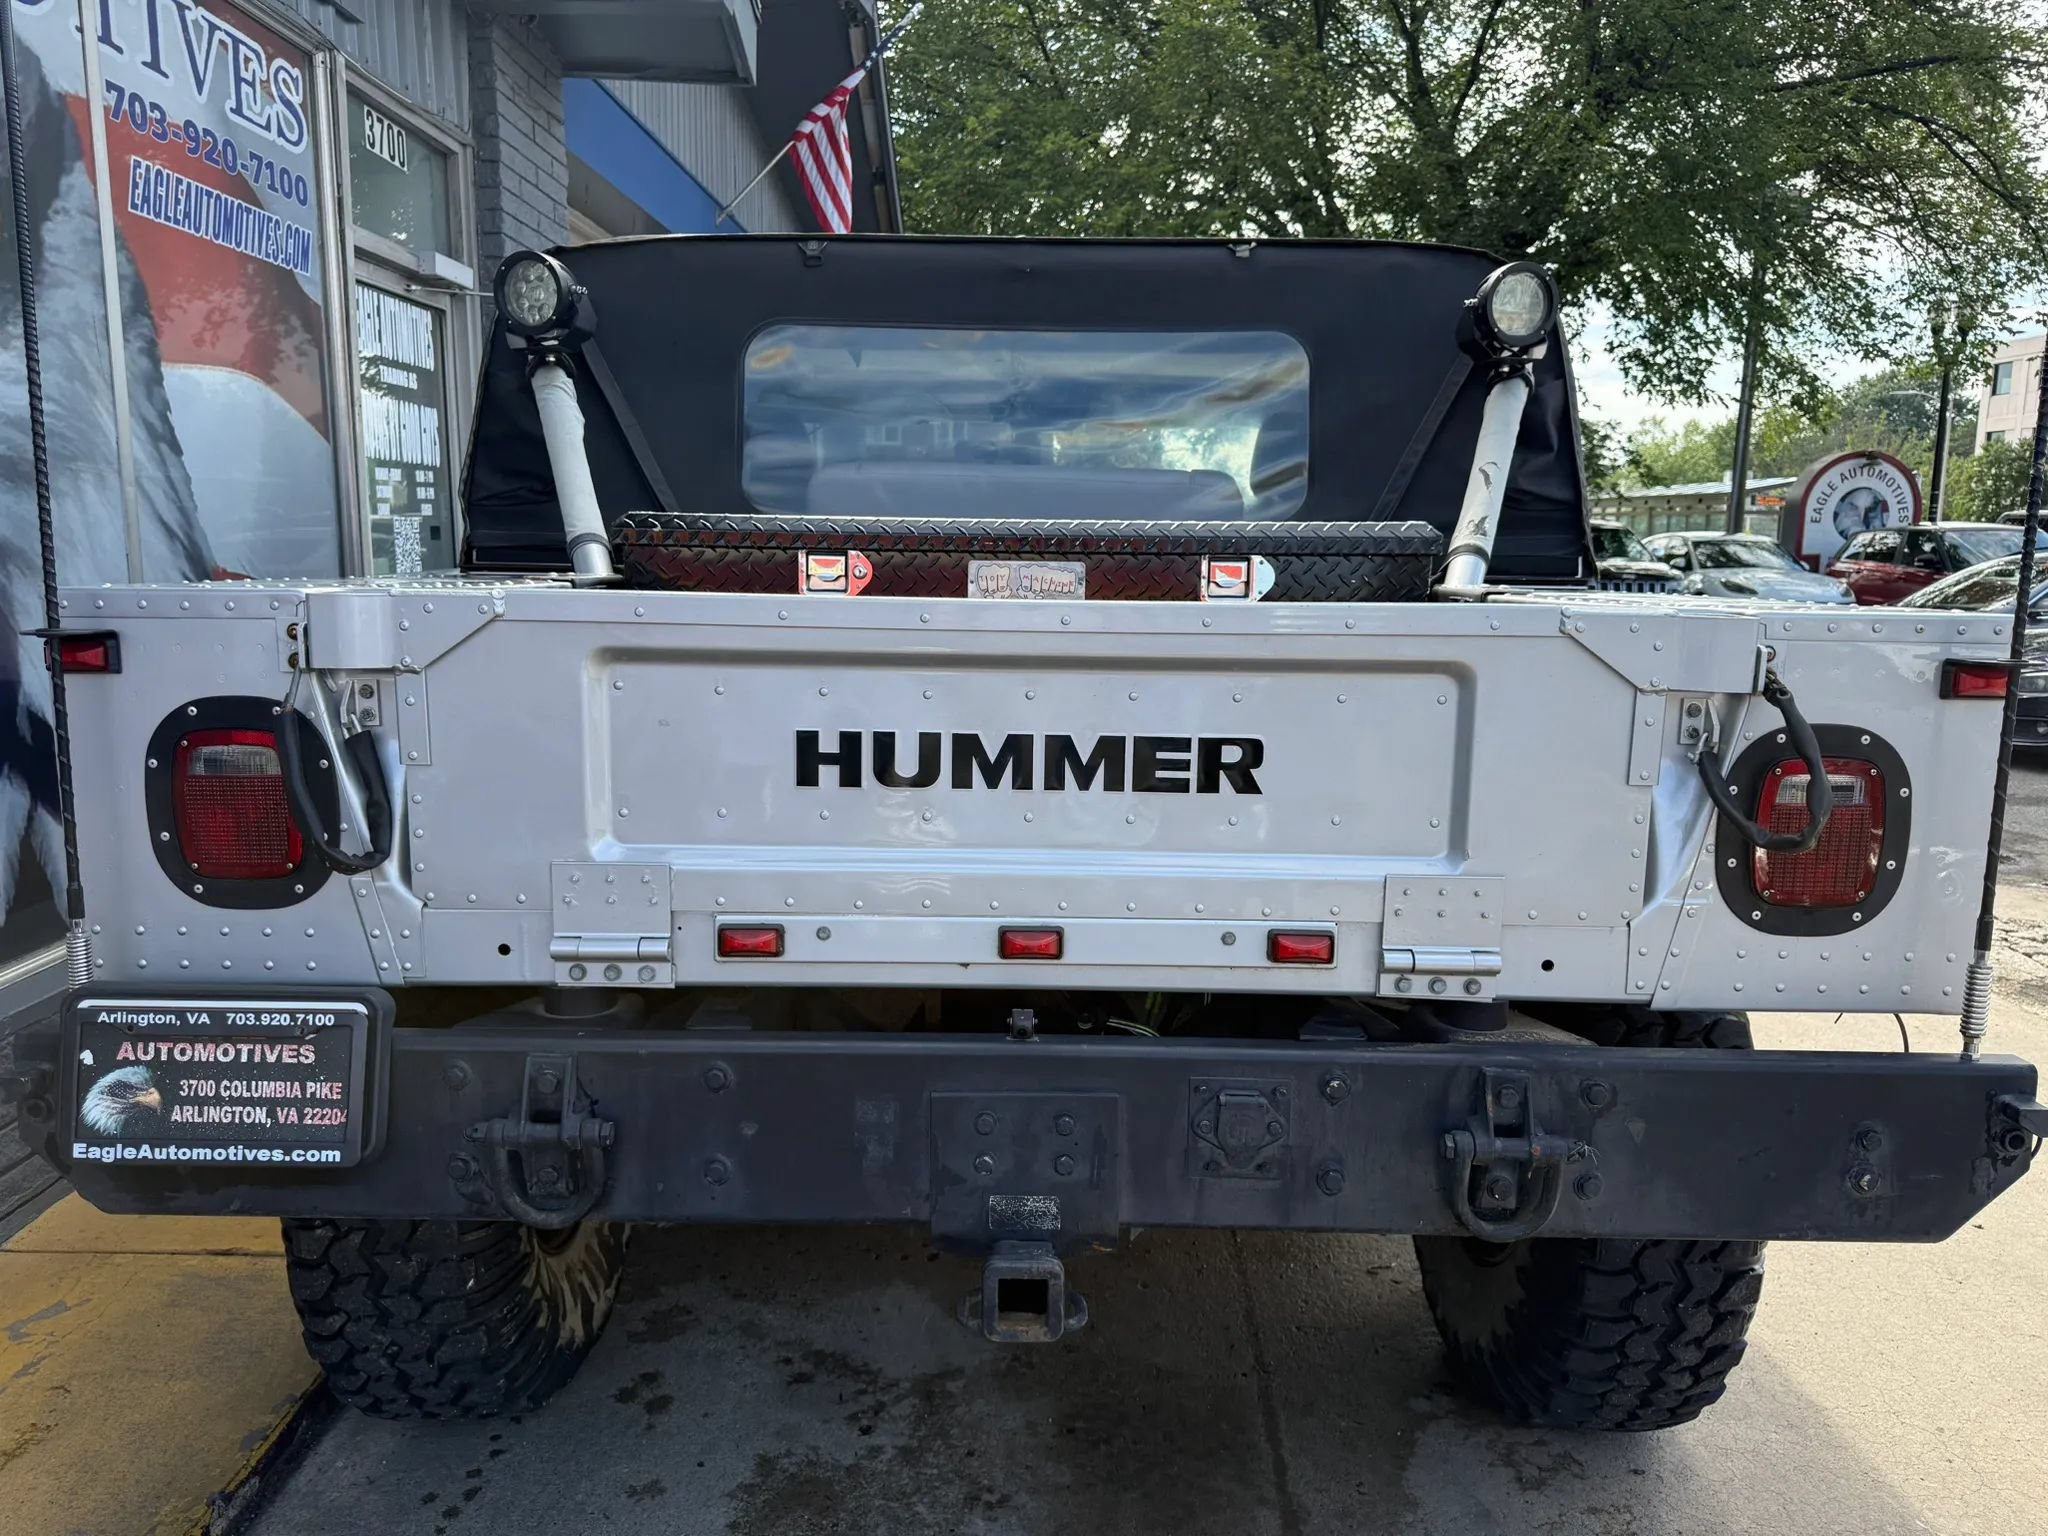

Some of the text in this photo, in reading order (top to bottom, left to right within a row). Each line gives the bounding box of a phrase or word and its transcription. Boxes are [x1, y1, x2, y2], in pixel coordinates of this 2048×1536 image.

[104, 79, 309, 208] 703-920-7100
[366, 109, 405, 168] 3700
[129, 156, 312, 275] EAGLEAUTOMOTIVES.COM
[1810, 465, 1910, 524] EAGLE AUTOMOTIVES
[979, 574, 1006, 582] TOY
[795, 729, 1265, 794] HUMMER
[97, 1011, 335, 1026] Arlington, VA 703.920.7100
[116, 1041, 316, 1064] AUTOMOTIVES
[179, 1079, 342, 1100] 3700 COLUMBIA PIKE
[171, 1105, 272, 1127] ARLINGTON,
[276, 1107, 299, 1124] VA
[72, 1142, 341, 1163] EagleAutomotives.com
